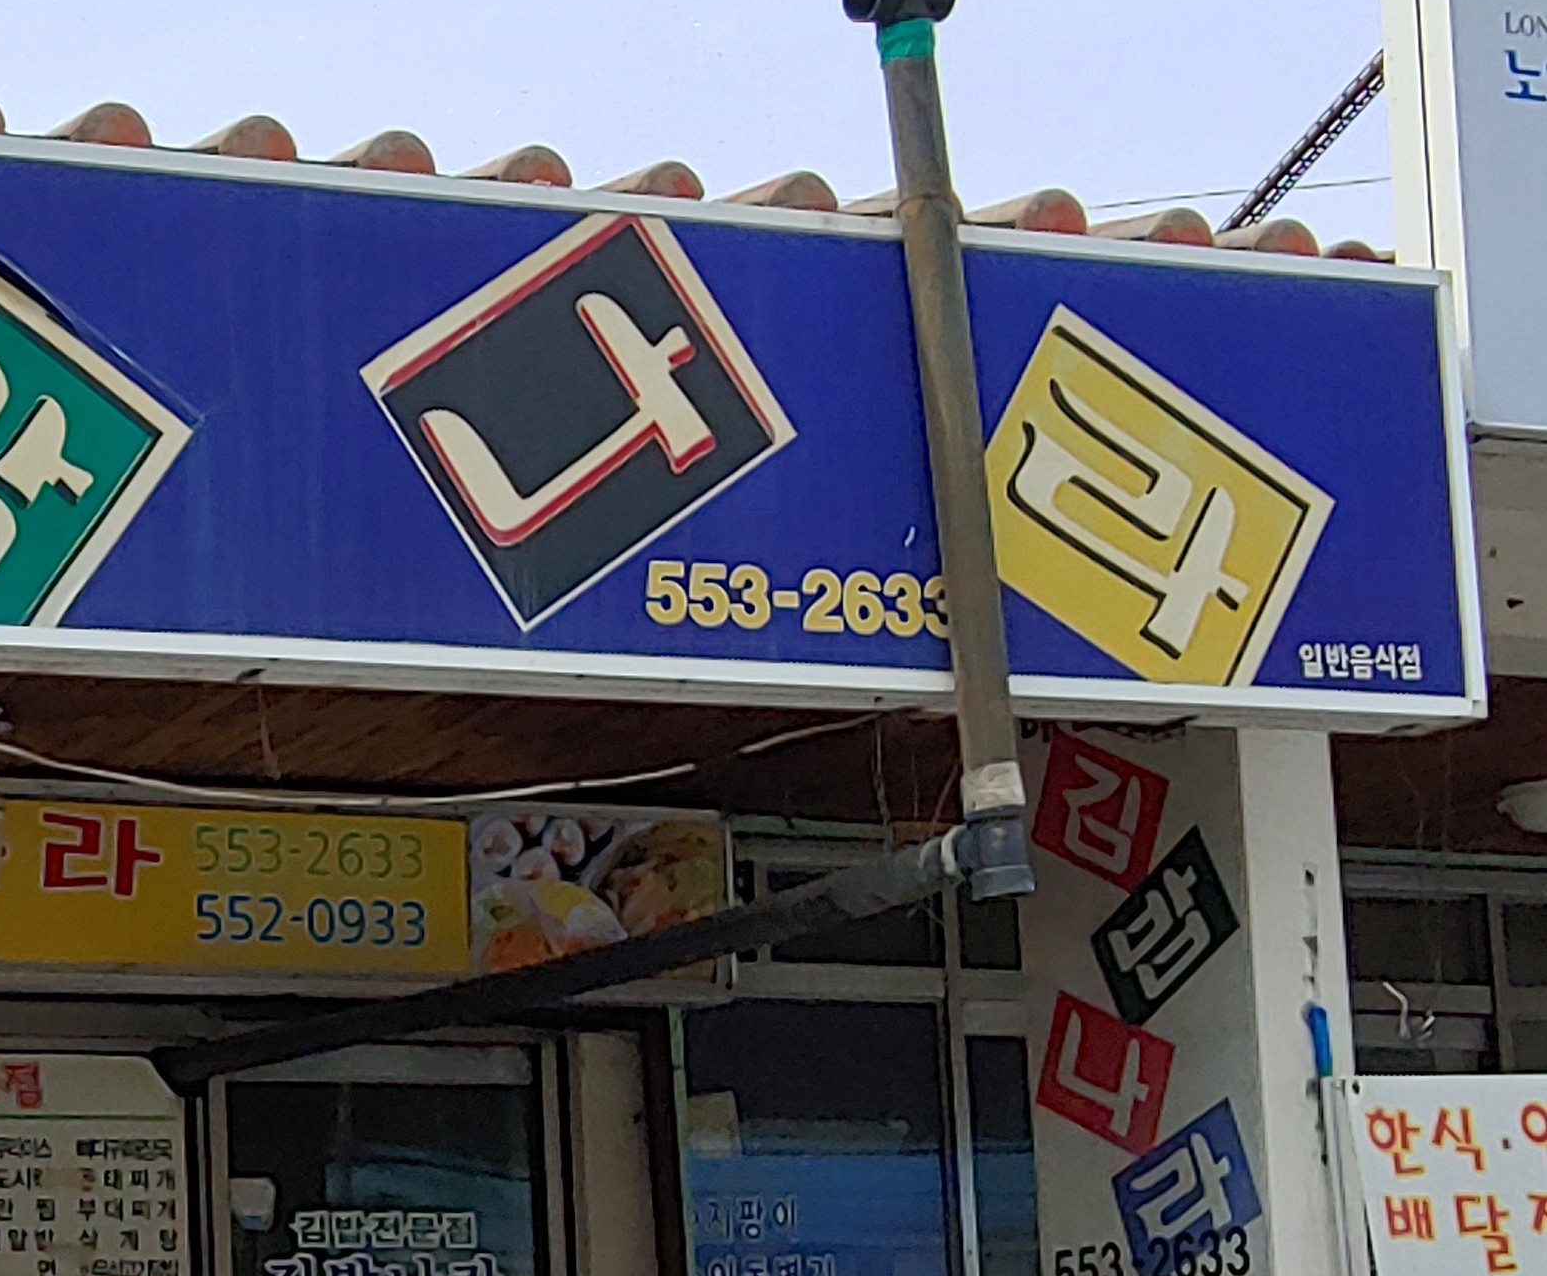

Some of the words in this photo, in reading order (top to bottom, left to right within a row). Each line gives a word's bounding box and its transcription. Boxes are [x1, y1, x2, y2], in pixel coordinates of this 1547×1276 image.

[1504, 49, 1547, 102] 노
[644, 559, 951, 640] 553-2633
[1298, 640, 1425, 685] 일반음식점
[193, 823, 427, 881] 553-2633
[194, 890, 429, 948] 552-0933
[288, 1210, 479, 1249] 김밥전문점
